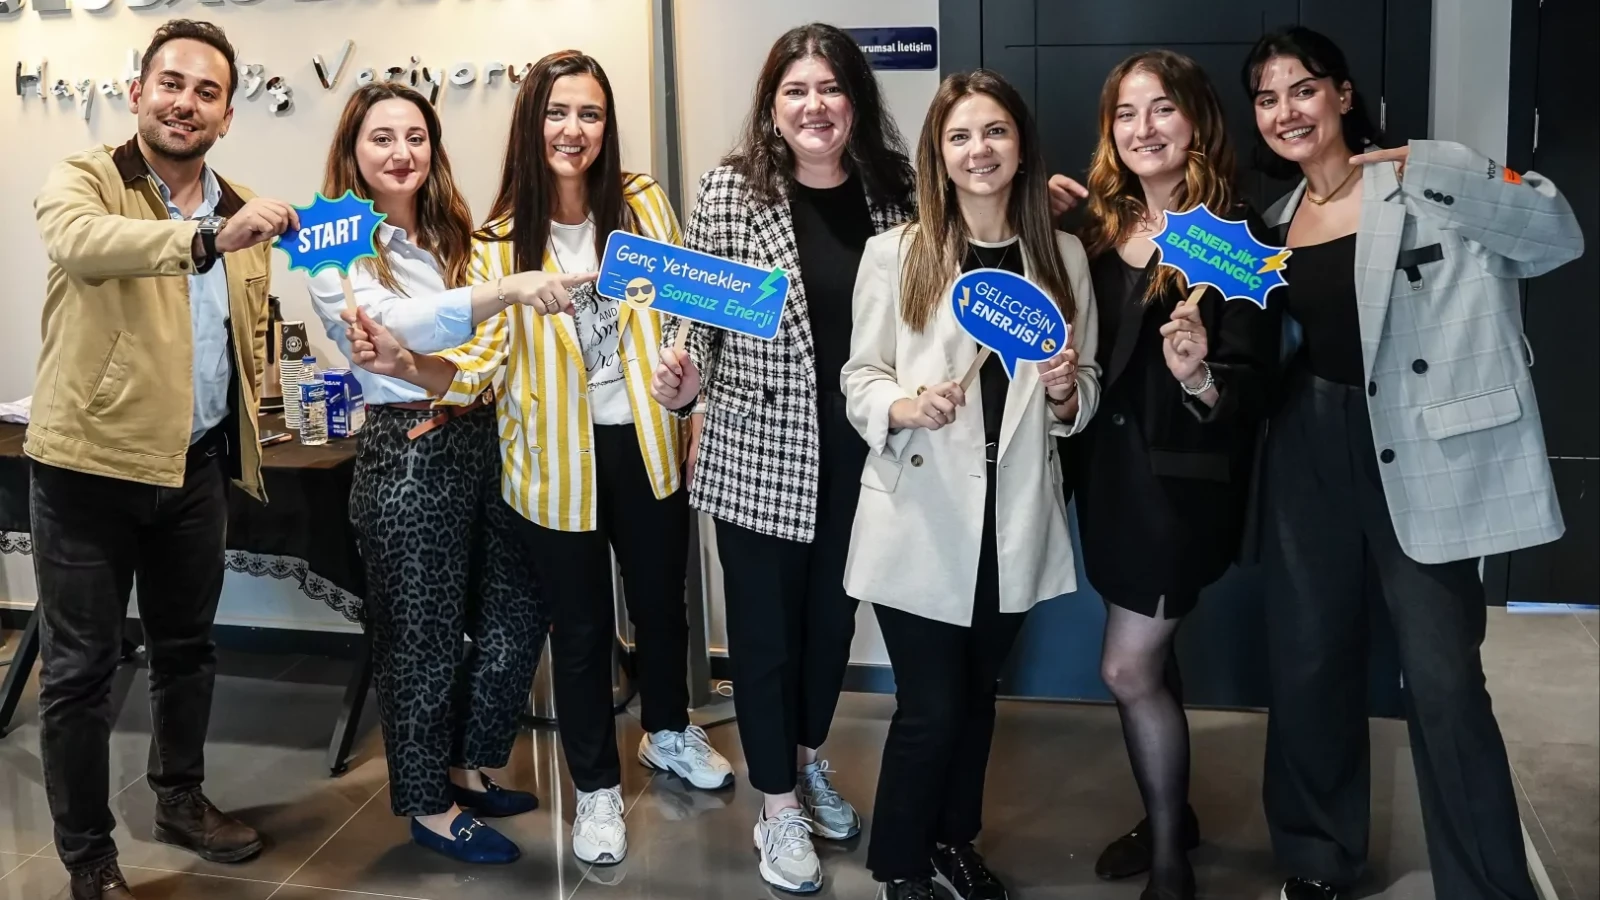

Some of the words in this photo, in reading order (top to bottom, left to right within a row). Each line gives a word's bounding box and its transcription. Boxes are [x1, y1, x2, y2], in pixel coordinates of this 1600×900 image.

[857, 43, 896, 53] urumsal
[897, 40, 932, 53] İletişim
[312, 39, 534, 108] Veriyoru
[298, 215, 362, 253] START
[1186, 224, 1259, 269] ENERJİK
[616, 245, 658, 273] Genç
[662, 256, 751, 295] Yetenekler
[1165, 232, 1262, 290] BAŞLANGIÇ
[600, 307, 618, 323] AND
[659, 284, 717, 311] Sonsuz
[723, 299, 776, 329] Enerji
[971, 300, 1041, 346] ENERJİSİ
[975, 281, 1056, 335] GELECEĞİN
